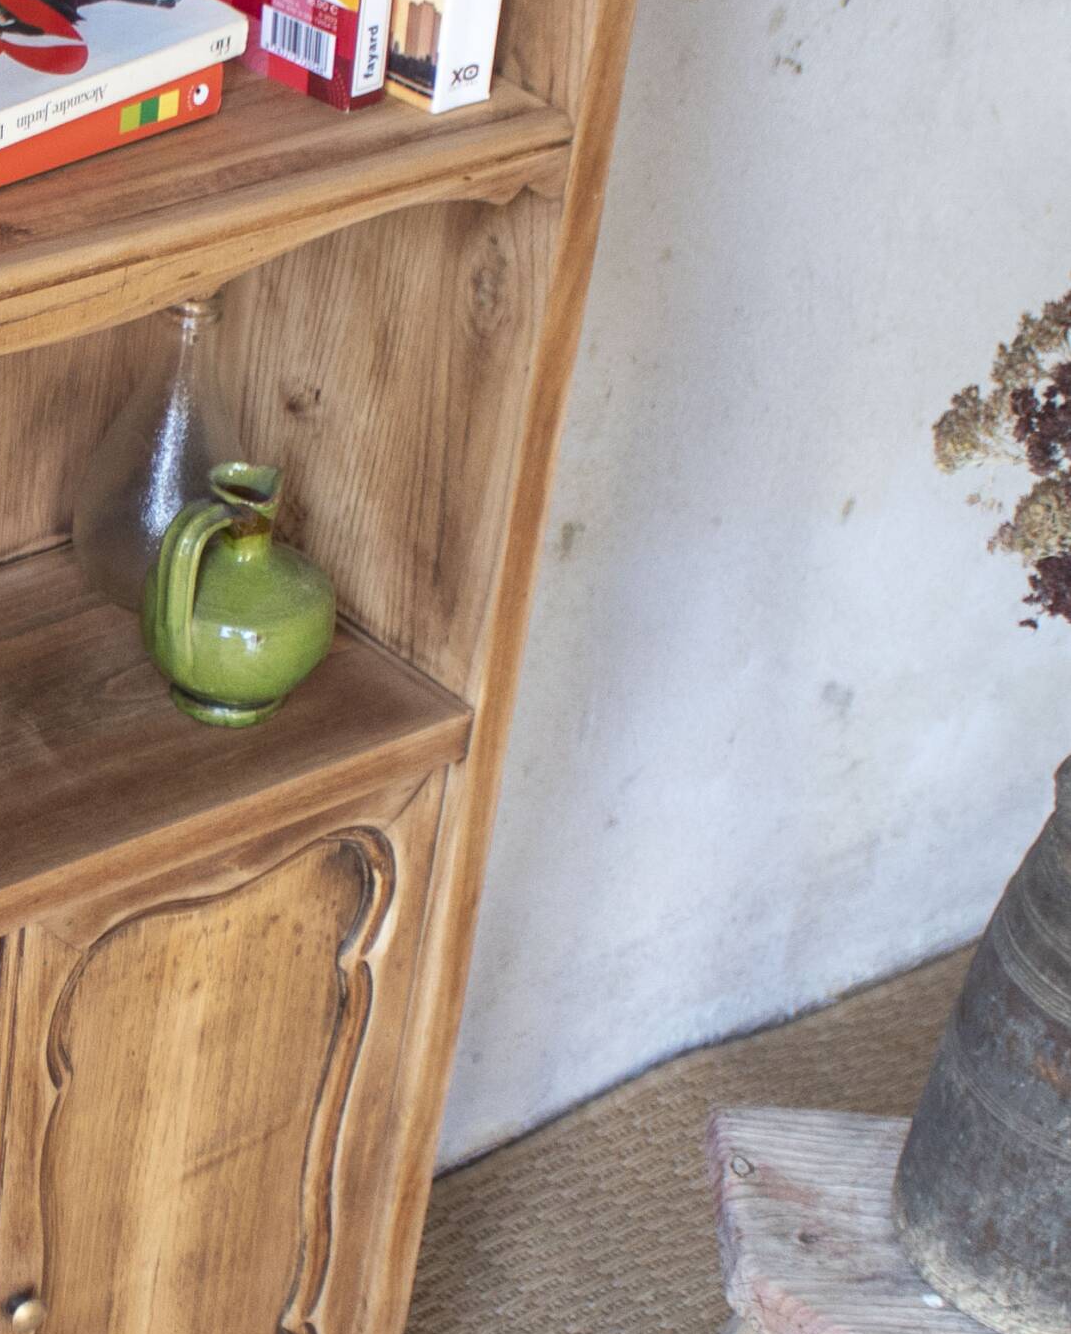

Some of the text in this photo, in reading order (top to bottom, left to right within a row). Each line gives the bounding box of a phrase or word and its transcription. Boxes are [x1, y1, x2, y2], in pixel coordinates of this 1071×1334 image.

[363, 24, 379, 79] fayard
[451, 64, 479, 86] XO
[16, 83, 108, 131] Alexandre Jardin
